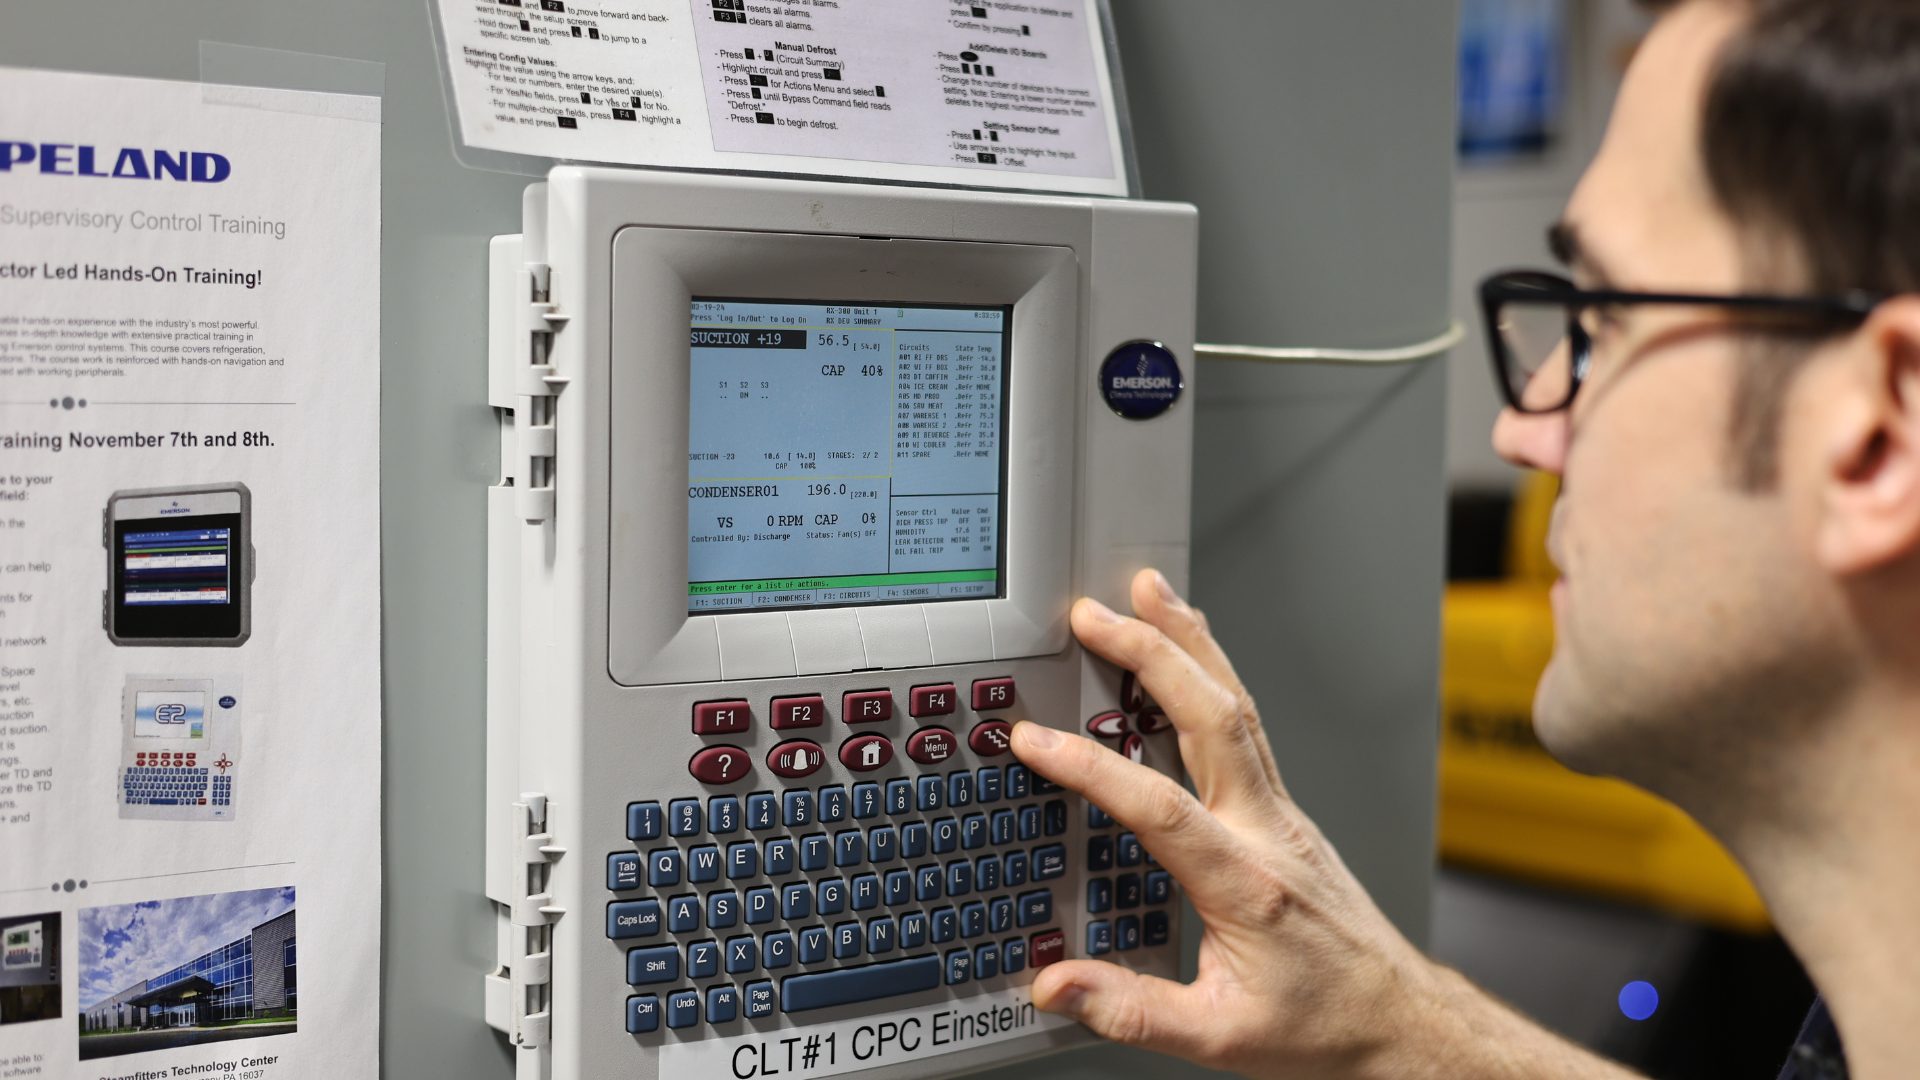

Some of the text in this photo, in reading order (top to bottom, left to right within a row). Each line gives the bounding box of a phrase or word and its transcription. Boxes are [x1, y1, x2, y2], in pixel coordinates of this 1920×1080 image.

[600, 10, 630, 19] forward
[648, 14, 670, 22] back-
[747, 6, 771, 14] resets
[784, 10, 812, 18] alarms.
[749, 17, 814, 31] clears all alarms.
[775, 41, 837, 56] Manual Defrost
[500, 52, 526, 65] Config
[776, 54, 845, 70] (Circuit Summary)
[573, 72, 616, 86] arrow keys,
[602, 84, 664, 99] desired value(s).
[784, 80, 875, 97] Actions Menu select
[782, 94, 851, 108] Bypass Command
[642, 116, 674, 126] highlight
[787, 118, 838, 130] begin defrost.
[983, 121, 1009, 132] Setting
[0, 205, 286, 240] Supervisory Control Training
[43, 263, 78, 280] Led
[85, 264, 177, 284] Hands-On
[184, 268, 262, 290] Training!
[854, 308, 870, 316] Unit
[68, 318, 117, 328] experience
[120, 318, 136, 327] with
[156, 319, 196, 330] industry's
[198, 321, 220, 329] most
[782, 316, 795, 324] Log
[854, 318, 881, 326] SUMMARY
[131, 330, 244, 343] extensive practical training
[690, 332, 782, 345] SUCTION +19
[818, 334, 850, 346] 56.5
[130, 344, 266, 356] This course covers refrigeration,
[900, 344, 930, 352] Circuits
[116, 355, 284, 368] reinforced with hands-on navigation and
[822, 364, 884, 376] CAP 40%
[1112, 377, 1172, 389] EMERSON
[69, 432, 164, 448] November
[170, 432, 198, 447] 7th
[204, 432, 236, 447] and
[242, 431, 274, 447] 8th.
[764, 452, 780, 460] 10.6
[26, 475, 53, 488] your
[688, 484, 779, 498] CONDENSER01
[808, 484, 846, 496] 196.0
[160, 508, 190, 516] EMERSON
[717, 512, 876, 528] VS 0 RPM CAP 0%
[738, 534, 750, 542] By:
[754, 533, 790, 542] Discharge
[806, 531, 834, 539] Status:
[798, 580, 829, 588] actions.
[774, 594, 810, 602] CONDENSER
[840, 591, 870, 599] CIRCUITS
[6, 636, 47, 647] network
[2, 666, 36, 680] Space
[930, 694, 945, 708] F4
[990, 688, 1006, 701] F5
[155, 703, 186, 725] E2
[792, 706, 810, 721] F2
[864, 700, 880, 716] F3
[716, 710, 734, 726] F1
[924, 742, 948, 753] Menu
[970, 821, 980, 836] P
[844, 837, 854, 851] Y
[877, 833, 887, 846] U
[774, 846, 784, 860] R
[809, 842, 819, 856] T
[698, 853, 714, 868] W
[736, 850, 746, 864] E
[618, 861, 636, 871] Tab
[659, 857, 672, 872] Q
[925, 874, 934, 888] K
[955, 869, 962, 882] L
[860, 882, 870, 897] H
[893, 879, 900, 893] J
[792, 892, 800, 906] F
[826, 887, 838, 902] G
[717, 900, 728, 914] S
[754, 896, 765, 910] D
[678, 904, 690, 918] A
[618, 914, 656, 926] Caps Lock
[908, 920, 920, 934] M
[842, 930, 852, 944] B
[876, 925, 886, 940] N
[772, 940, 784, 956] C
[809, 935, 819, 948] V
[696, 948, 707, 964] Z
[735, 945, 746, 960] X
[646, 961, 666, 972] Shift
[718, 994, 730, 1004] Alt
[752, 990, 770, 1001] Page
[638, 1003, 652, 1014] Ctrl
[676, 998, 696, 1008] Undo
[752, 1002, 770, 1012] Down
[732, 997, 1035, 1080] CLT#1 CPC Einstein
[171, 1055, 278, 1077] Technology Center
[238, 1070, 264, 1080] 16037
